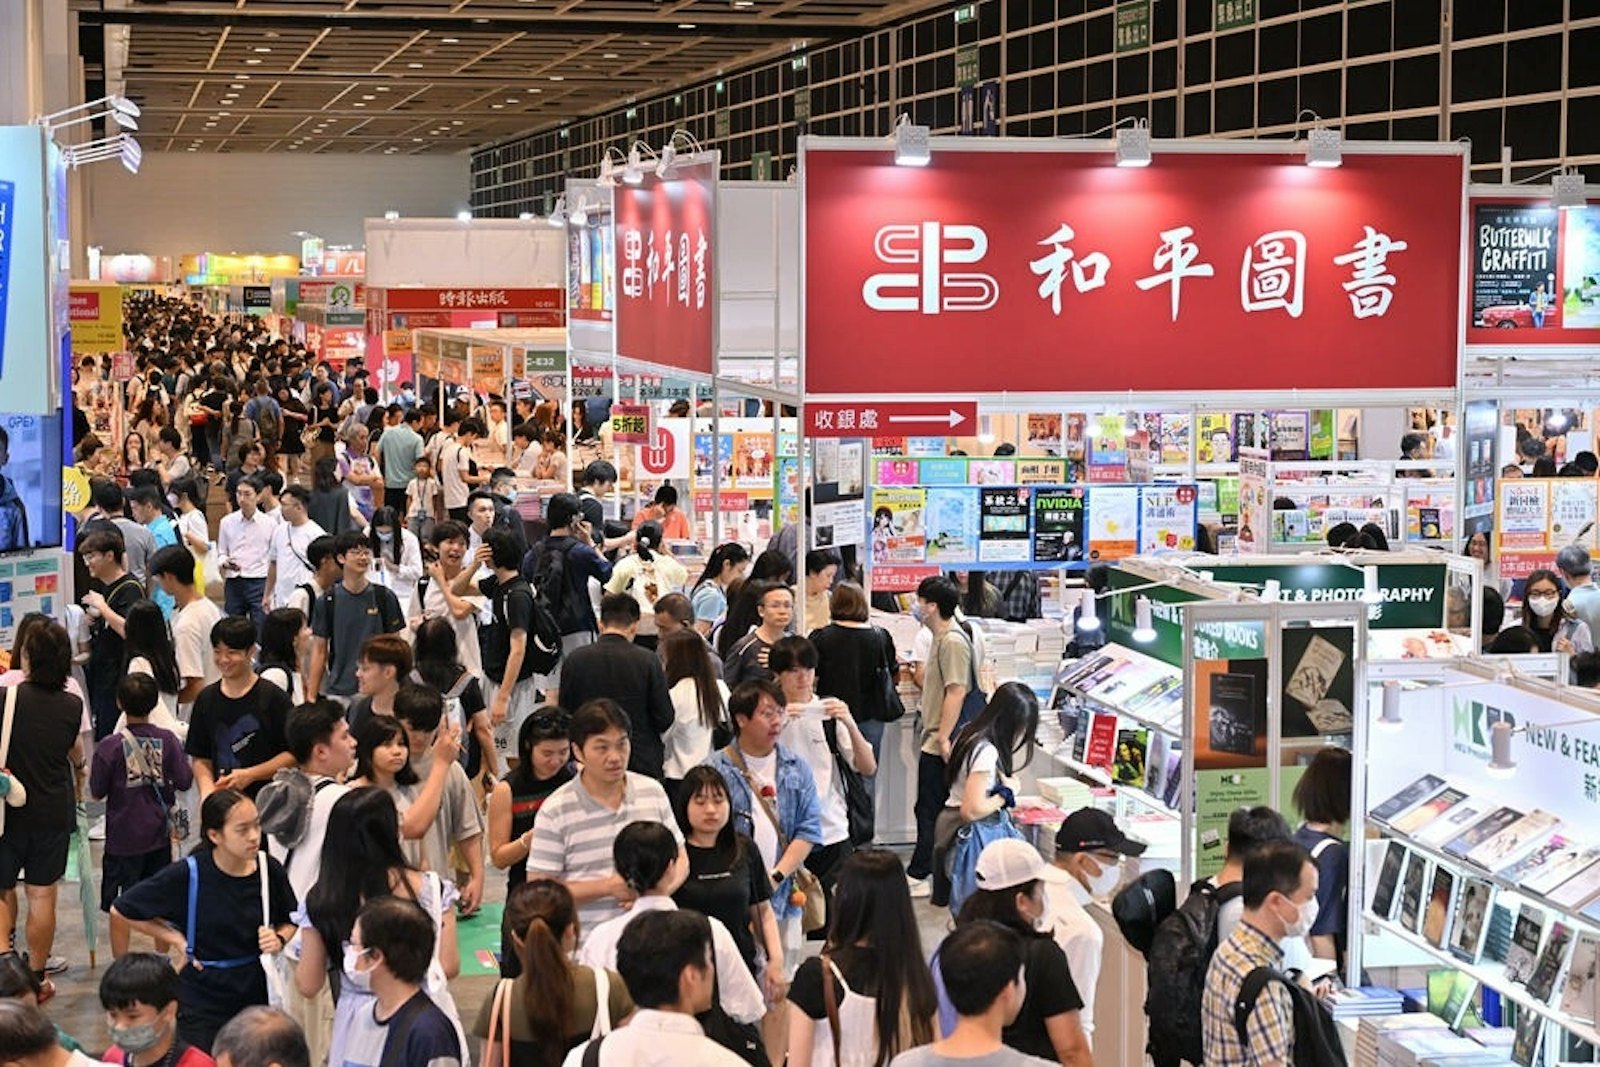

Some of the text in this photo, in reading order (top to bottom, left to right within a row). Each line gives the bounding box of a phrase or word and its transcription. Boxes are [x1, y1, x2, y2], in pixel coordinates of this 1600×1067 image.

[1480, 224, 1552, 249] BUTTERMILK
[645, 228, 708, 310] 和平圖書
[1029, 223, 1409, 321] 和平圖書
[1482, 247, 1547, 272] GRAFFITI
[612, 417, 645, 434] 5折起
[814, 408, 879, 430] 收銀處
[1037, 498, 1083, 510] NVIDIA
[1294, 588, 1308, 601] &
[1311, 588, 1435, 602] PHOTORAPHY
[1224, 621, 1258, 649] BOOKS
[1526, 721, 1557, 752] NEW
[1561, 733, 1571, 757] &
[1575, 738, 1600, 767] FEA
[1585, 773, 1600, 802] 新
